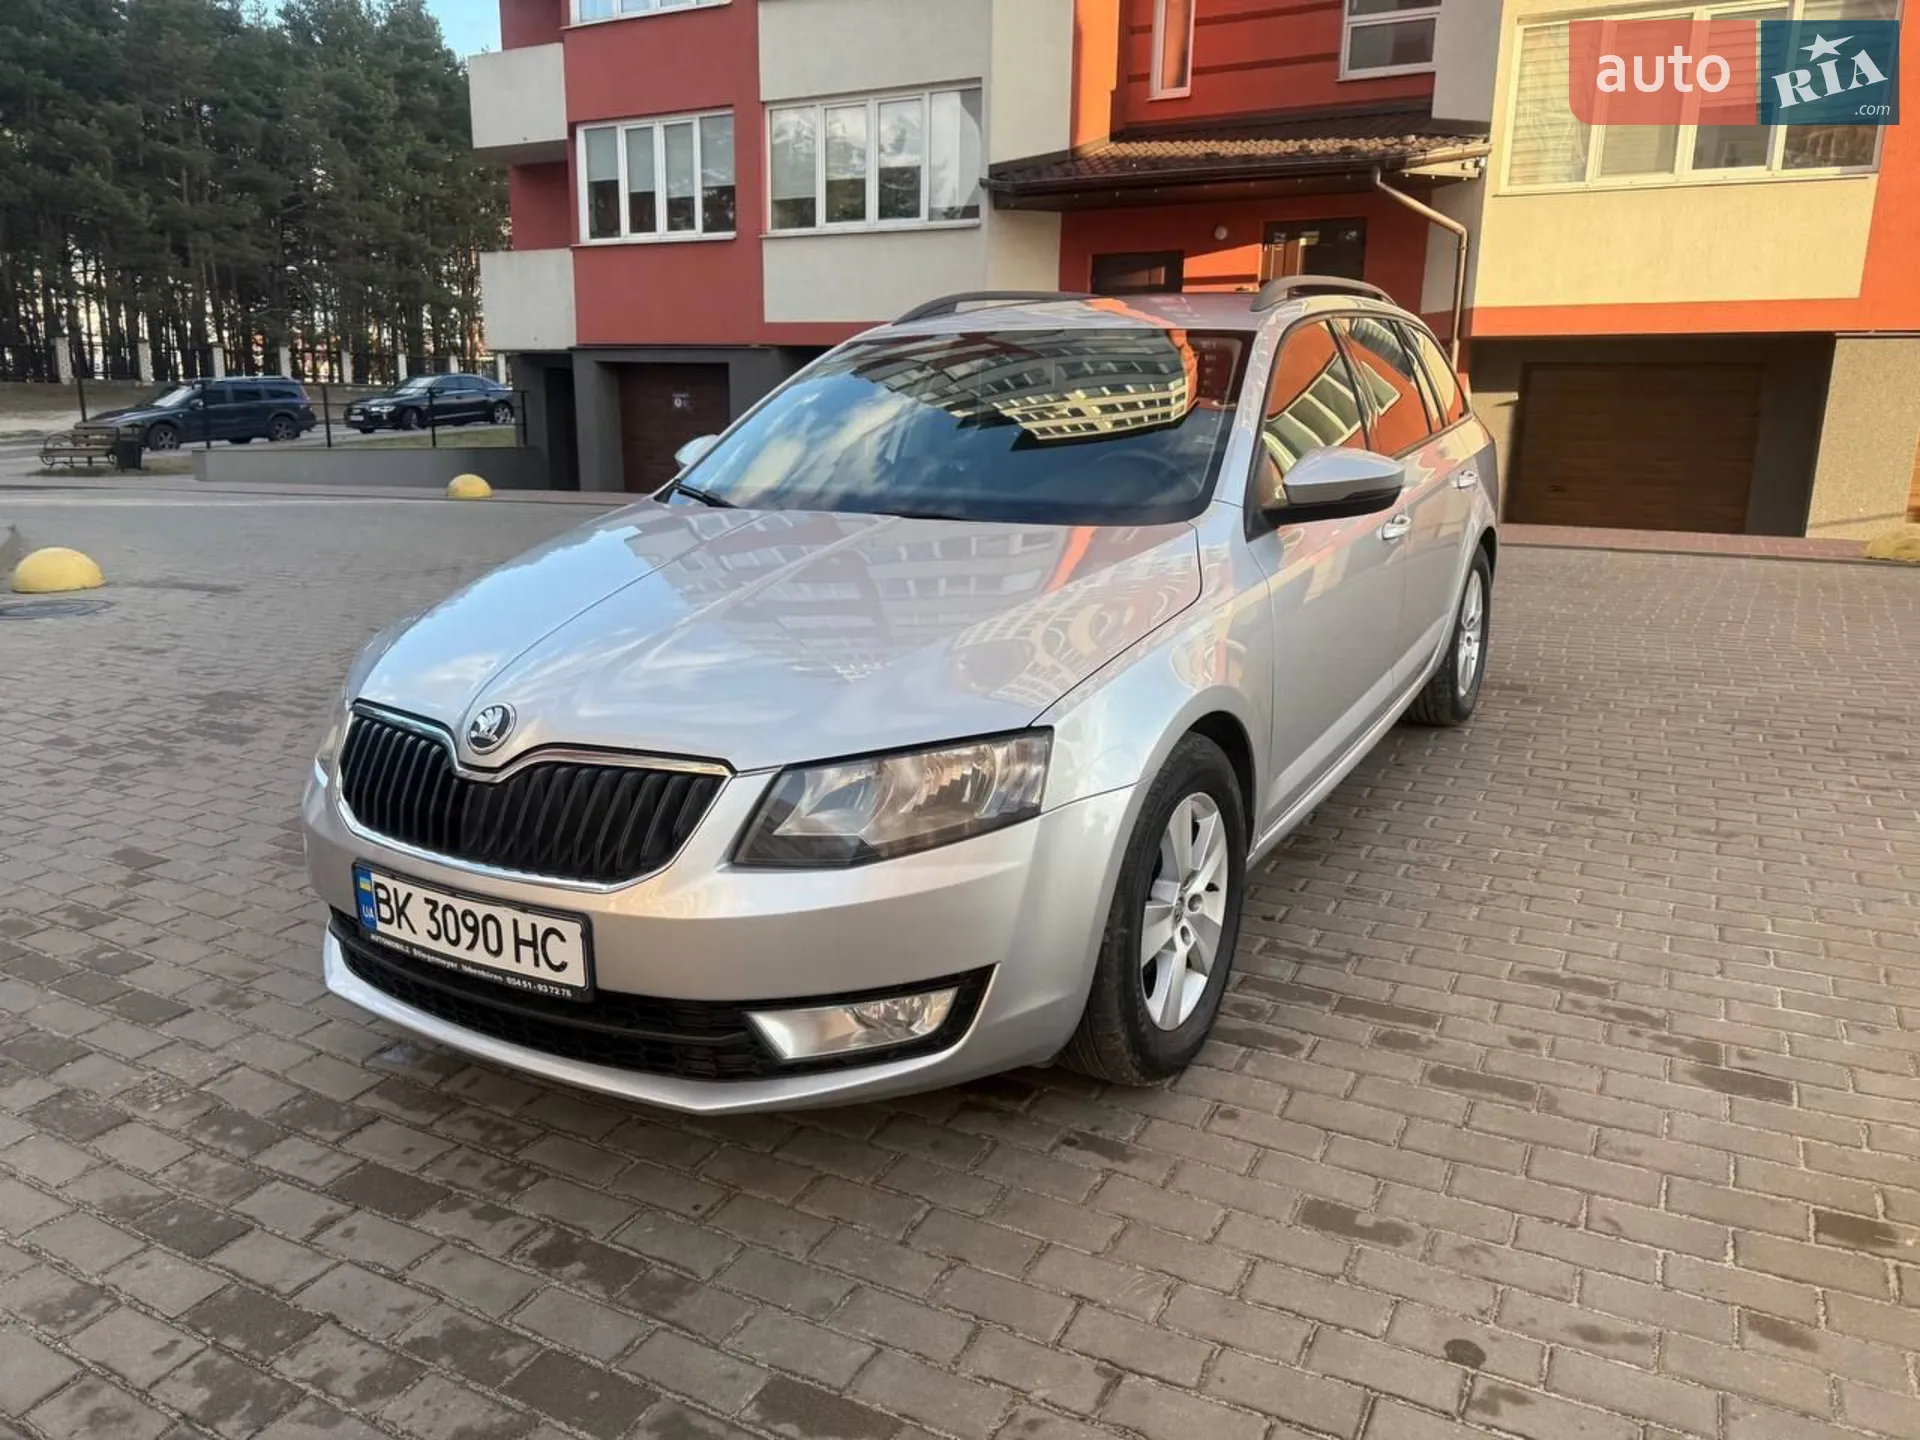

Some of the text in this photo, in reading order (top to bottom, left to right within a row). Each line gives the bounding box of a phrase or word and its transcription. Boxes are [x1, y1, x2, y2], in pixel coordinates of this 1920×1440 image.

[362, 904, 376, 920] UA
[374, 881, 568, 973] BK 3090 HC
